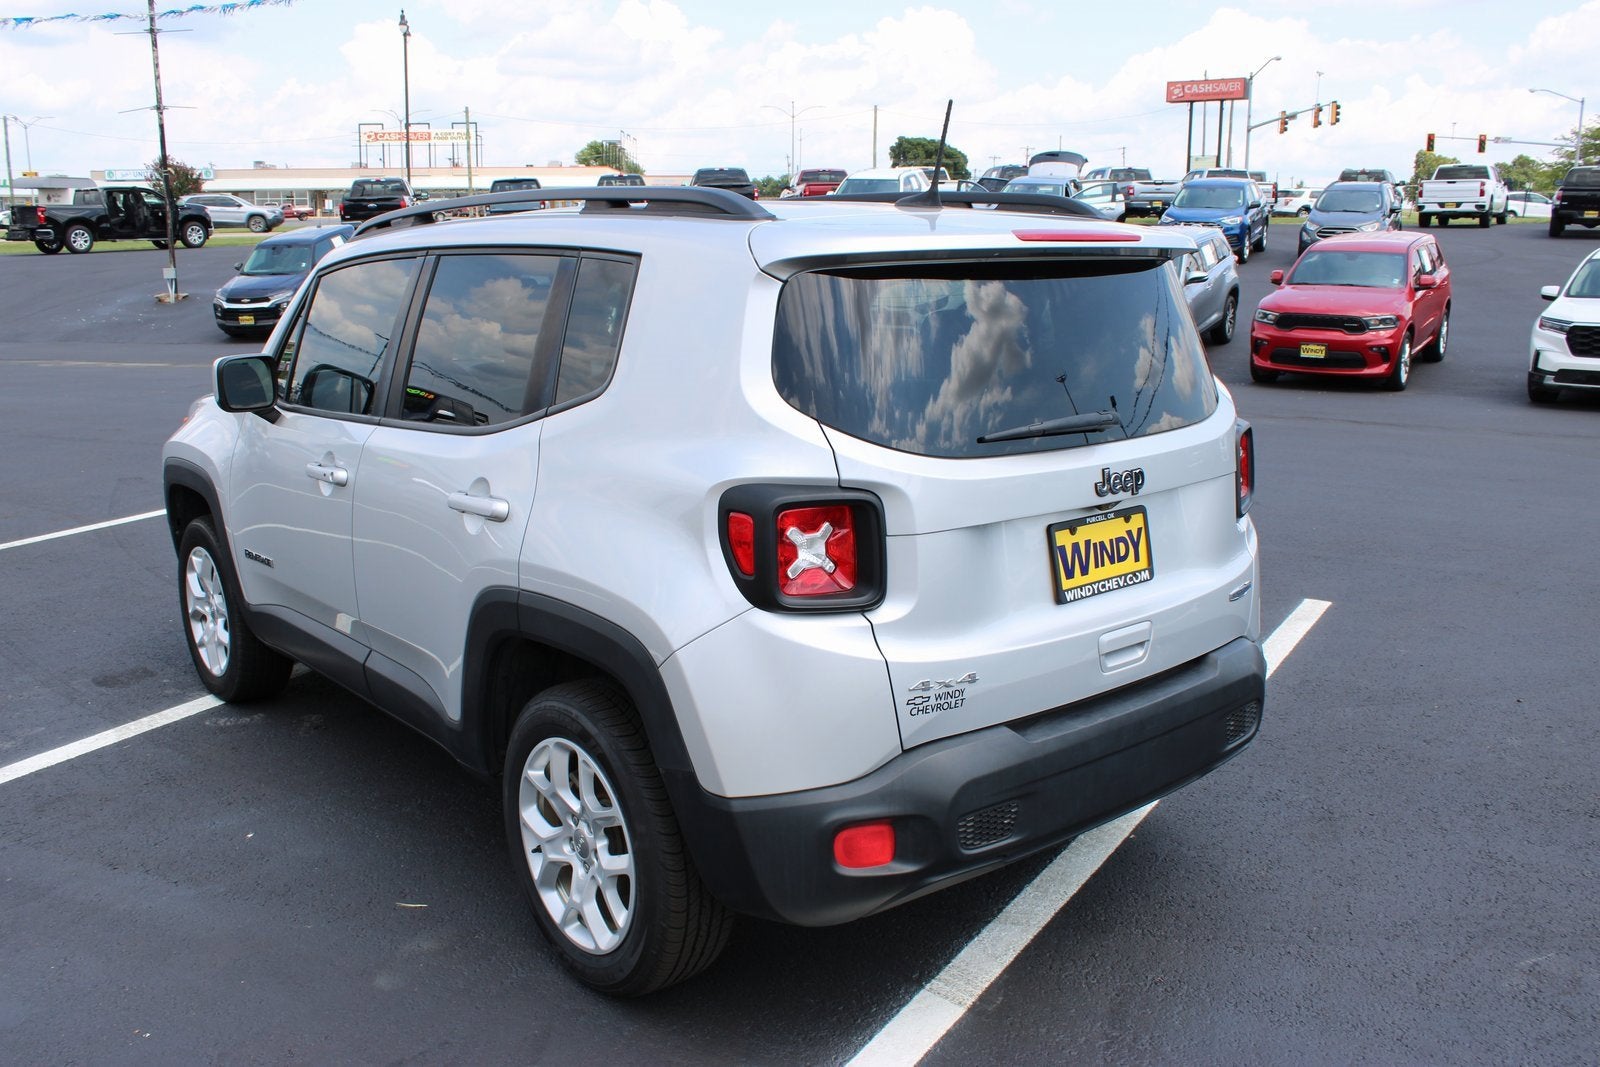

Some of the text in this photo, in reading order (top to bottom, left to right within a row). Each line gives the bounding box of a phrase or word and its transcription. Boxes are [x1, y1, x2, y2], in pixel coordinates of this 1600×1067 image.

[1184, 81, 1241, 93] CASHSAVER
[1095, 467, 1145, 498] Jeep
[1086, 513, 1107, 524] PURCELL,
[1056, 527, 1143, 580] WINDY
[1064, 570, 1151, 602] WINDYCHEV.COM
[934, 688, 966, 702] WINDY
[909, 698, 966, 717] CHEVROLET
